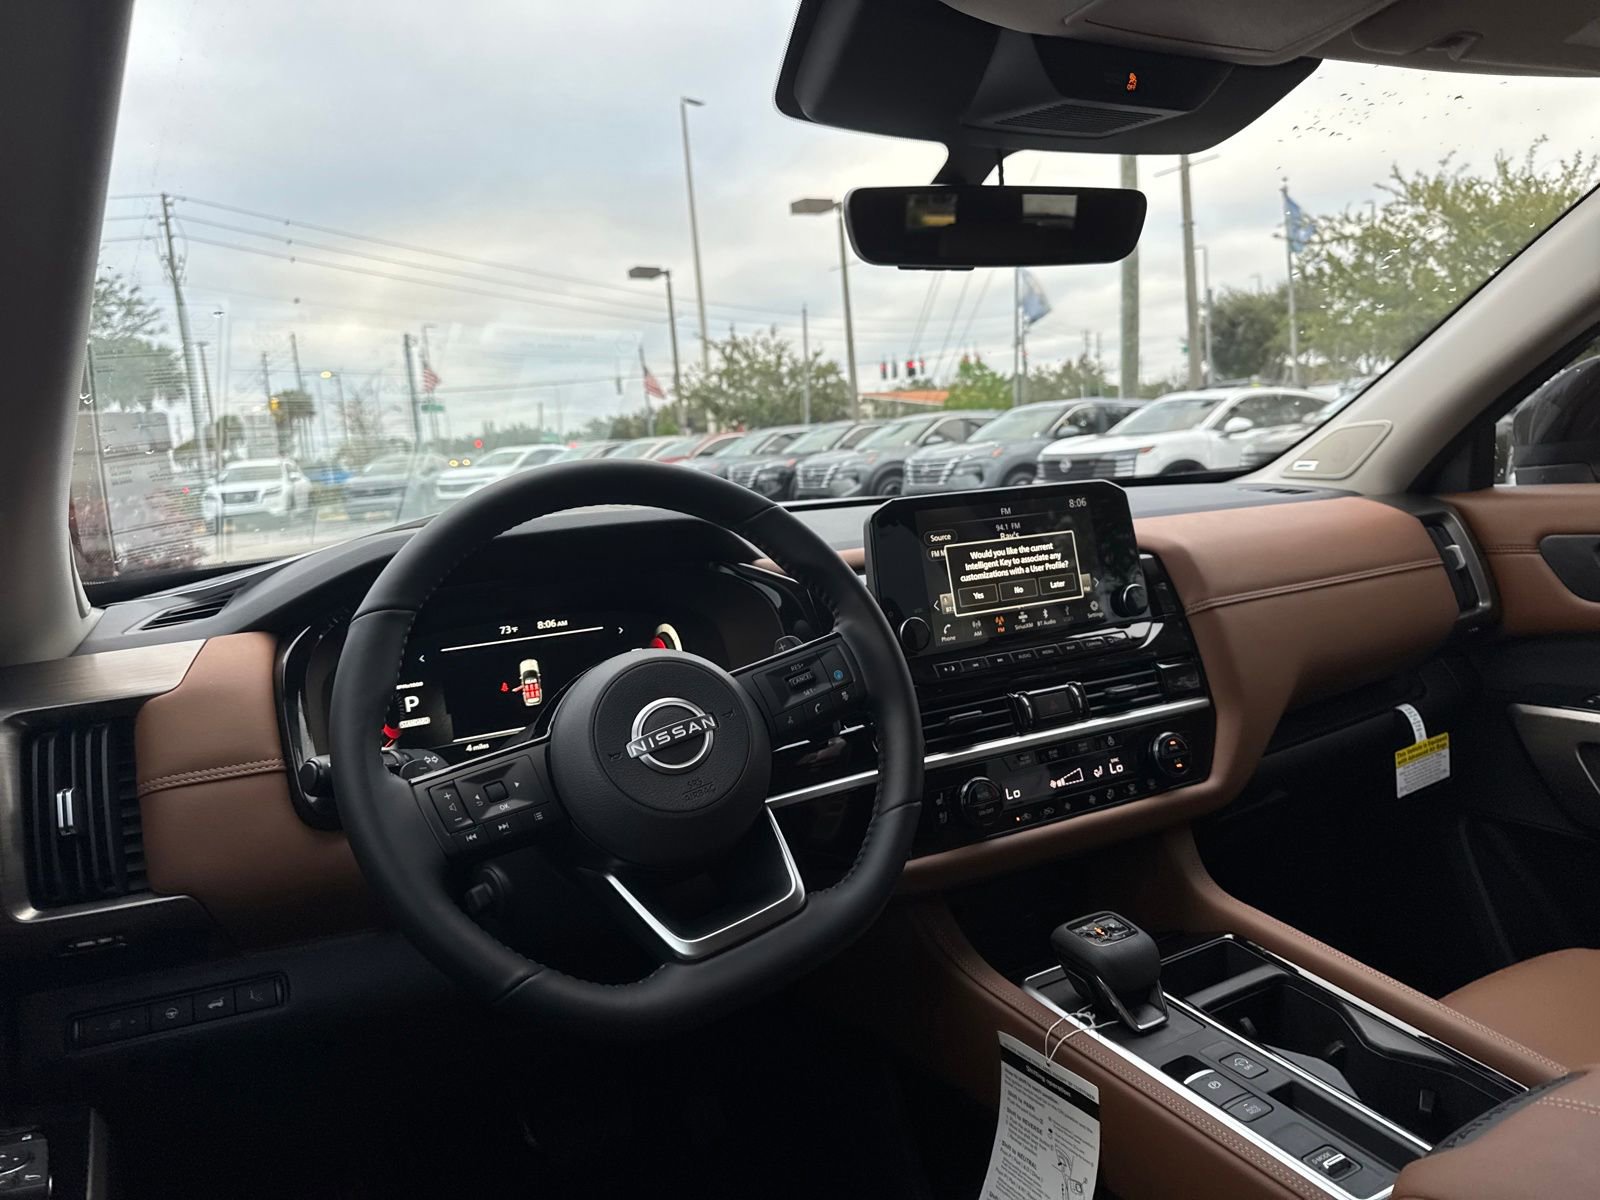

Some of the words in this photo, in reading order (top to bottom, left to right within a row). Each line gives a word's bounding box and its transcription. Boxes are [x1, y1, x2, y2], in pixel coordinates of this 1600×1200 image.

[1069, 497, 1087, 508] 8:06
[1000, 507, 1012, 515] FM
[930, 534, 952, 542] Source
[970, 549, 993, 560] Would
[993, 550, 1006, 559] you
[1006, 546, 1018, 555] like
[1019, 545, 1030, 554] the
[1031, 543, 1054, 552] current
[965, 559, 999, 571] Intelligent
[1000, 558, 1012, 568] Key
[1021, 553, 1049, 564] associate
[1050, 552, 1062, 561] any
[960, 570, 1009, 582] customizations
[1009, 566, 1024, 575] with
[1030, 564, 1045, 573] User
[1045, 560, 1069, 571] Profile?
[1014, 586, 1024, 594] No
[973, 592, 985, 600] Yes
[537, 619, 556, 630] 8:06
[404, 695, 420, 713] P
[630, 716, 716, 756] NISSAN
[465, 744, 473, 752] 4
[473, 743, 490, 751] miles
[1109, 763, 1124, 774] Lo
[1005, 787, 1021, 800] Lo
[500, 803, 510, 811] OK
